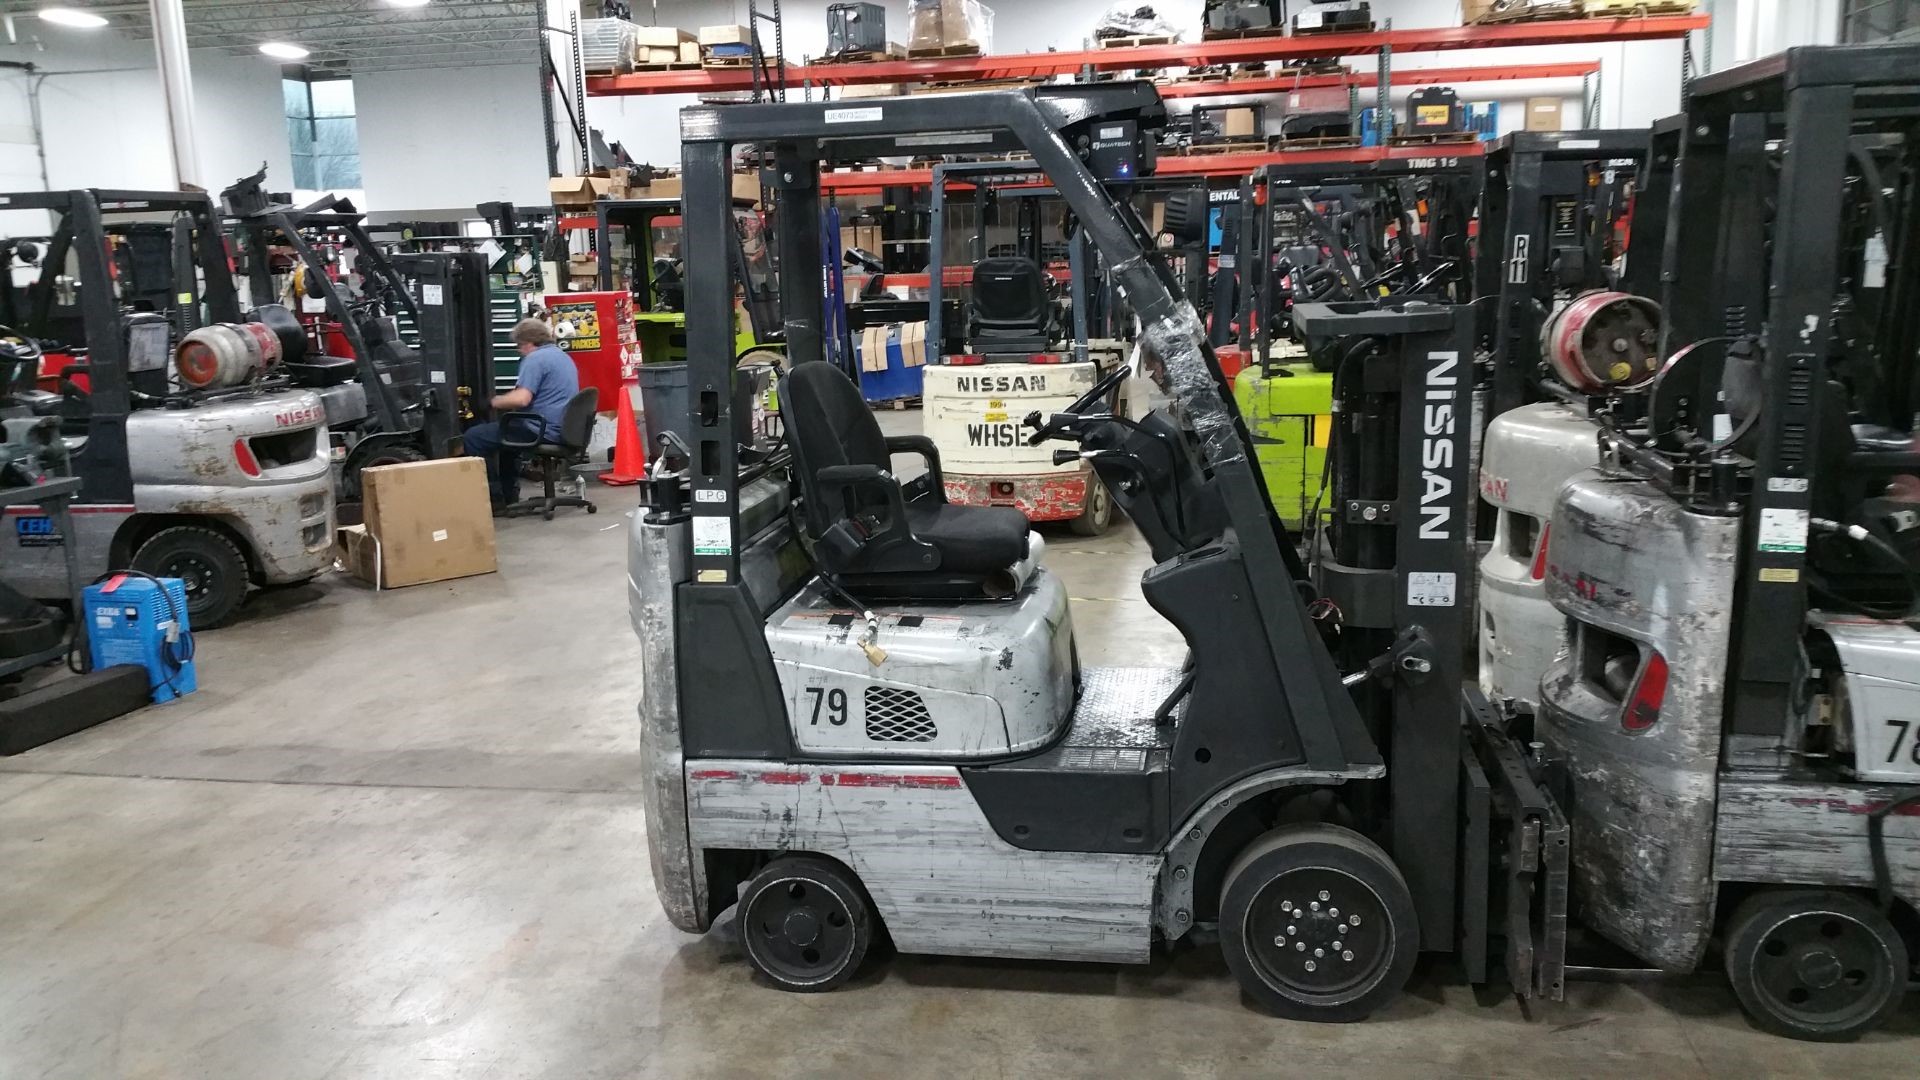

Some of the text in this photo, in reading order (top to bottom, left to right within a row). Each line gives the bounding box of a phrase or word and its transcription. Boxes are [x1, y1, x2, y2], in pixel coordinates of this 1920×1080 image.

[1209, 191, 1240, 202] ENTAL
[1516, 236, 1527, 259] R
[957, 375, 1046, 392] NISSAN
[967, 424, 1028, 447] WHSE
[1419, 351, 1459, 540] NISSAN
[698, 490, 725, 501] LPG
[806, 687, 848, 727] 79
